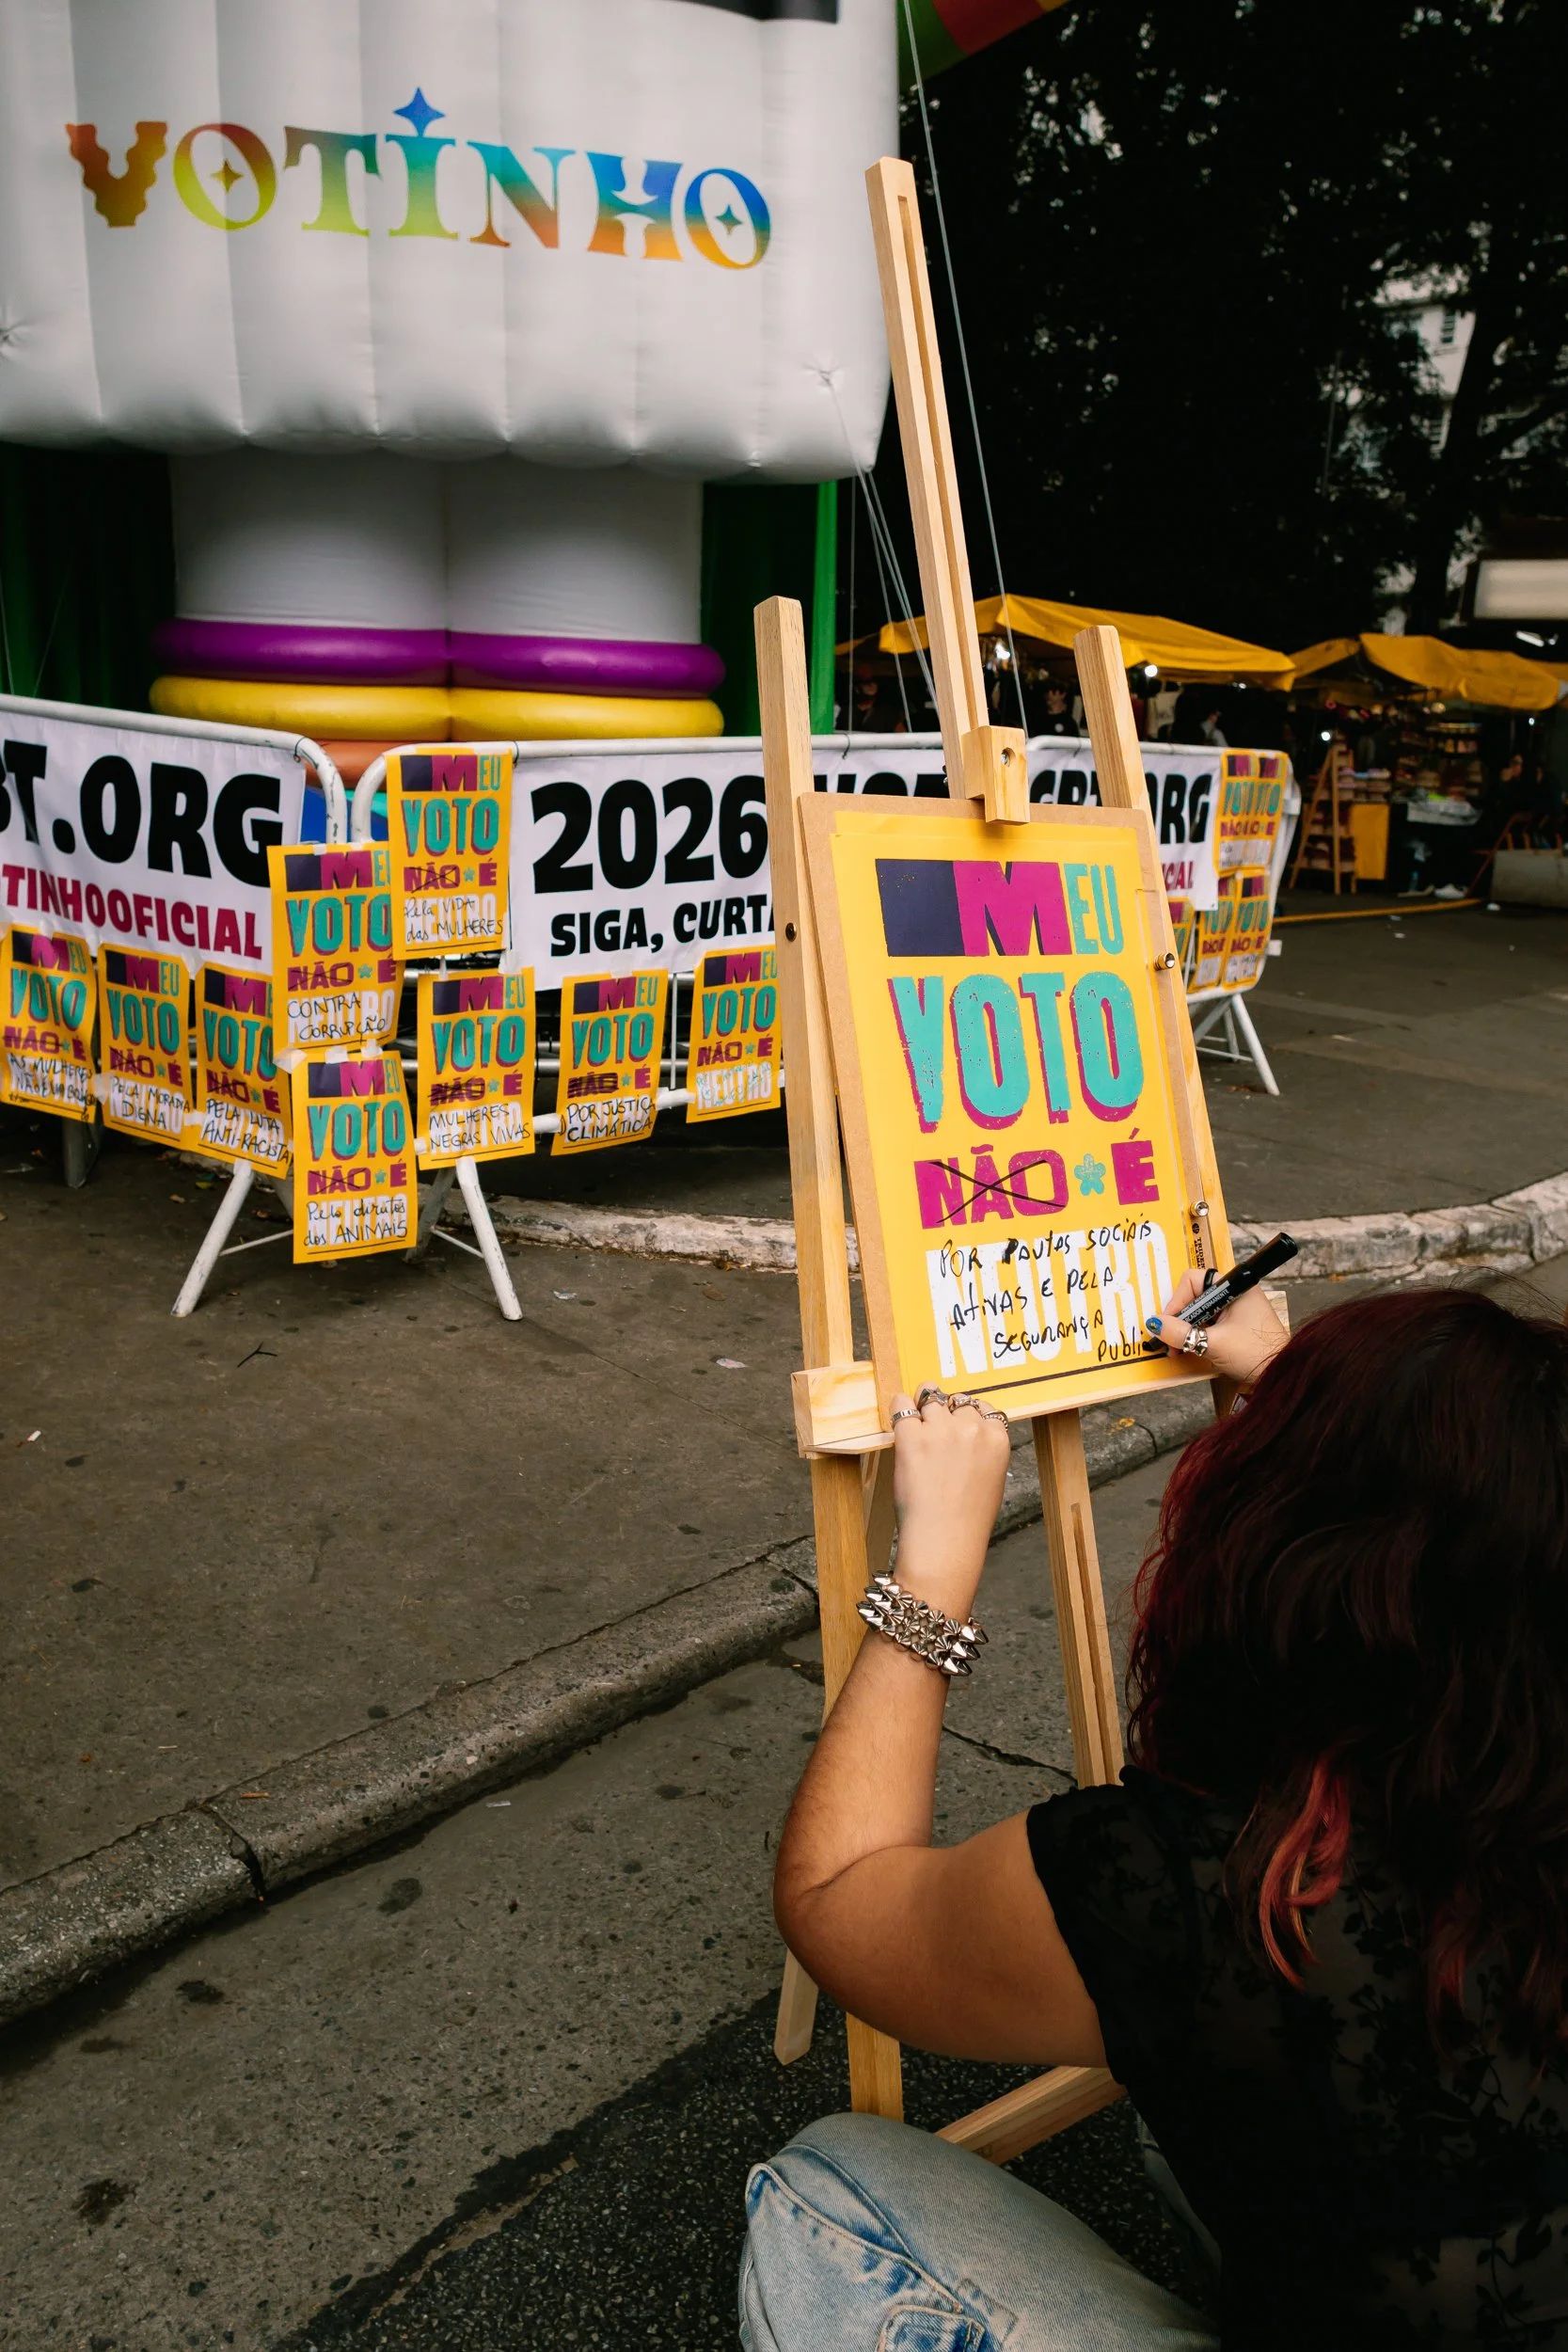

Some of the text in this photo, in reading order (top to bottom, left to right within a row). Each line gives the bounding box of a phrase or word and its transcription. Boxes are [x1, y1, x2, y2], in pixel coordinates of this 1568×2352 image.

[65, 87, 772, 270] VOTINHO
[432, 755, 501, 791] MEU
[0, 739, 284, 888] T.ORG
[401, 797, 499, 857] VOTO
[530, 774, 768, 894] 2026
[321, 850, 390, 890] ME
[479, 858, 498, 886] É
[442, 897, 476, 913] VIDA
[953, 859, 1123, 957] MEU
[286, 894, 393, 957] VOTO
[436, 917, 503, 938] MULHERES
[550, 894, 776, 957] SIGA, CURT
[125, 954, 180, 997] MEU
[377, 953, 397, 983] É
[10, 967, 87, 1032] VOTO
[287, 992, 361, 1019] CONTRA
[459, 975, 526, 1012] MEU
[598, 977, 658, 1011] MEU
[107, 989, 180, 1056] VOTO
[702, 985, 776, 1040] VOTO
[72, 1037, 87, 1062] É
[203, 1009, 278, 1082] VOTO
[431, 1015, 526, 1075] VOTO
[572, 1012, 655, 1070] VOTO
[757, 1033, 773, 1057] É
[887, 972, 1145, 1133] VOTO
[167, 1059, 183, 1087] É
[340, 1058, 401, 1097] MEU
[503, 1070, 523, 1096] É
[635, 1064, 652, 1089] É
[696, 1061, 773, 1110] NEUTRO
[122, 1101, 167, 1130] DIGNA
[206, 1098, 280, 1136] PELA LUTA
[263, 1086, 281, 1114] É
[429, 1104, 510, 1129] MULHERES
[566, 1104, 600, 1124] POR
[307, 1100, 405, 1162] VOTO
[430, 1122, 531, 1150] NEGRAS VIVAS
[390, 1158, 407, 1188] É
[913, 1128, 1160, 1229] NÃO É
[303, 1229, 327, 1248] dos
[1196, 1236, 1205, 1269] TRIDEN
[940, 1239, 983, 1278] POR
[1202, 1288, 1231, 1311] PERMANENTE
